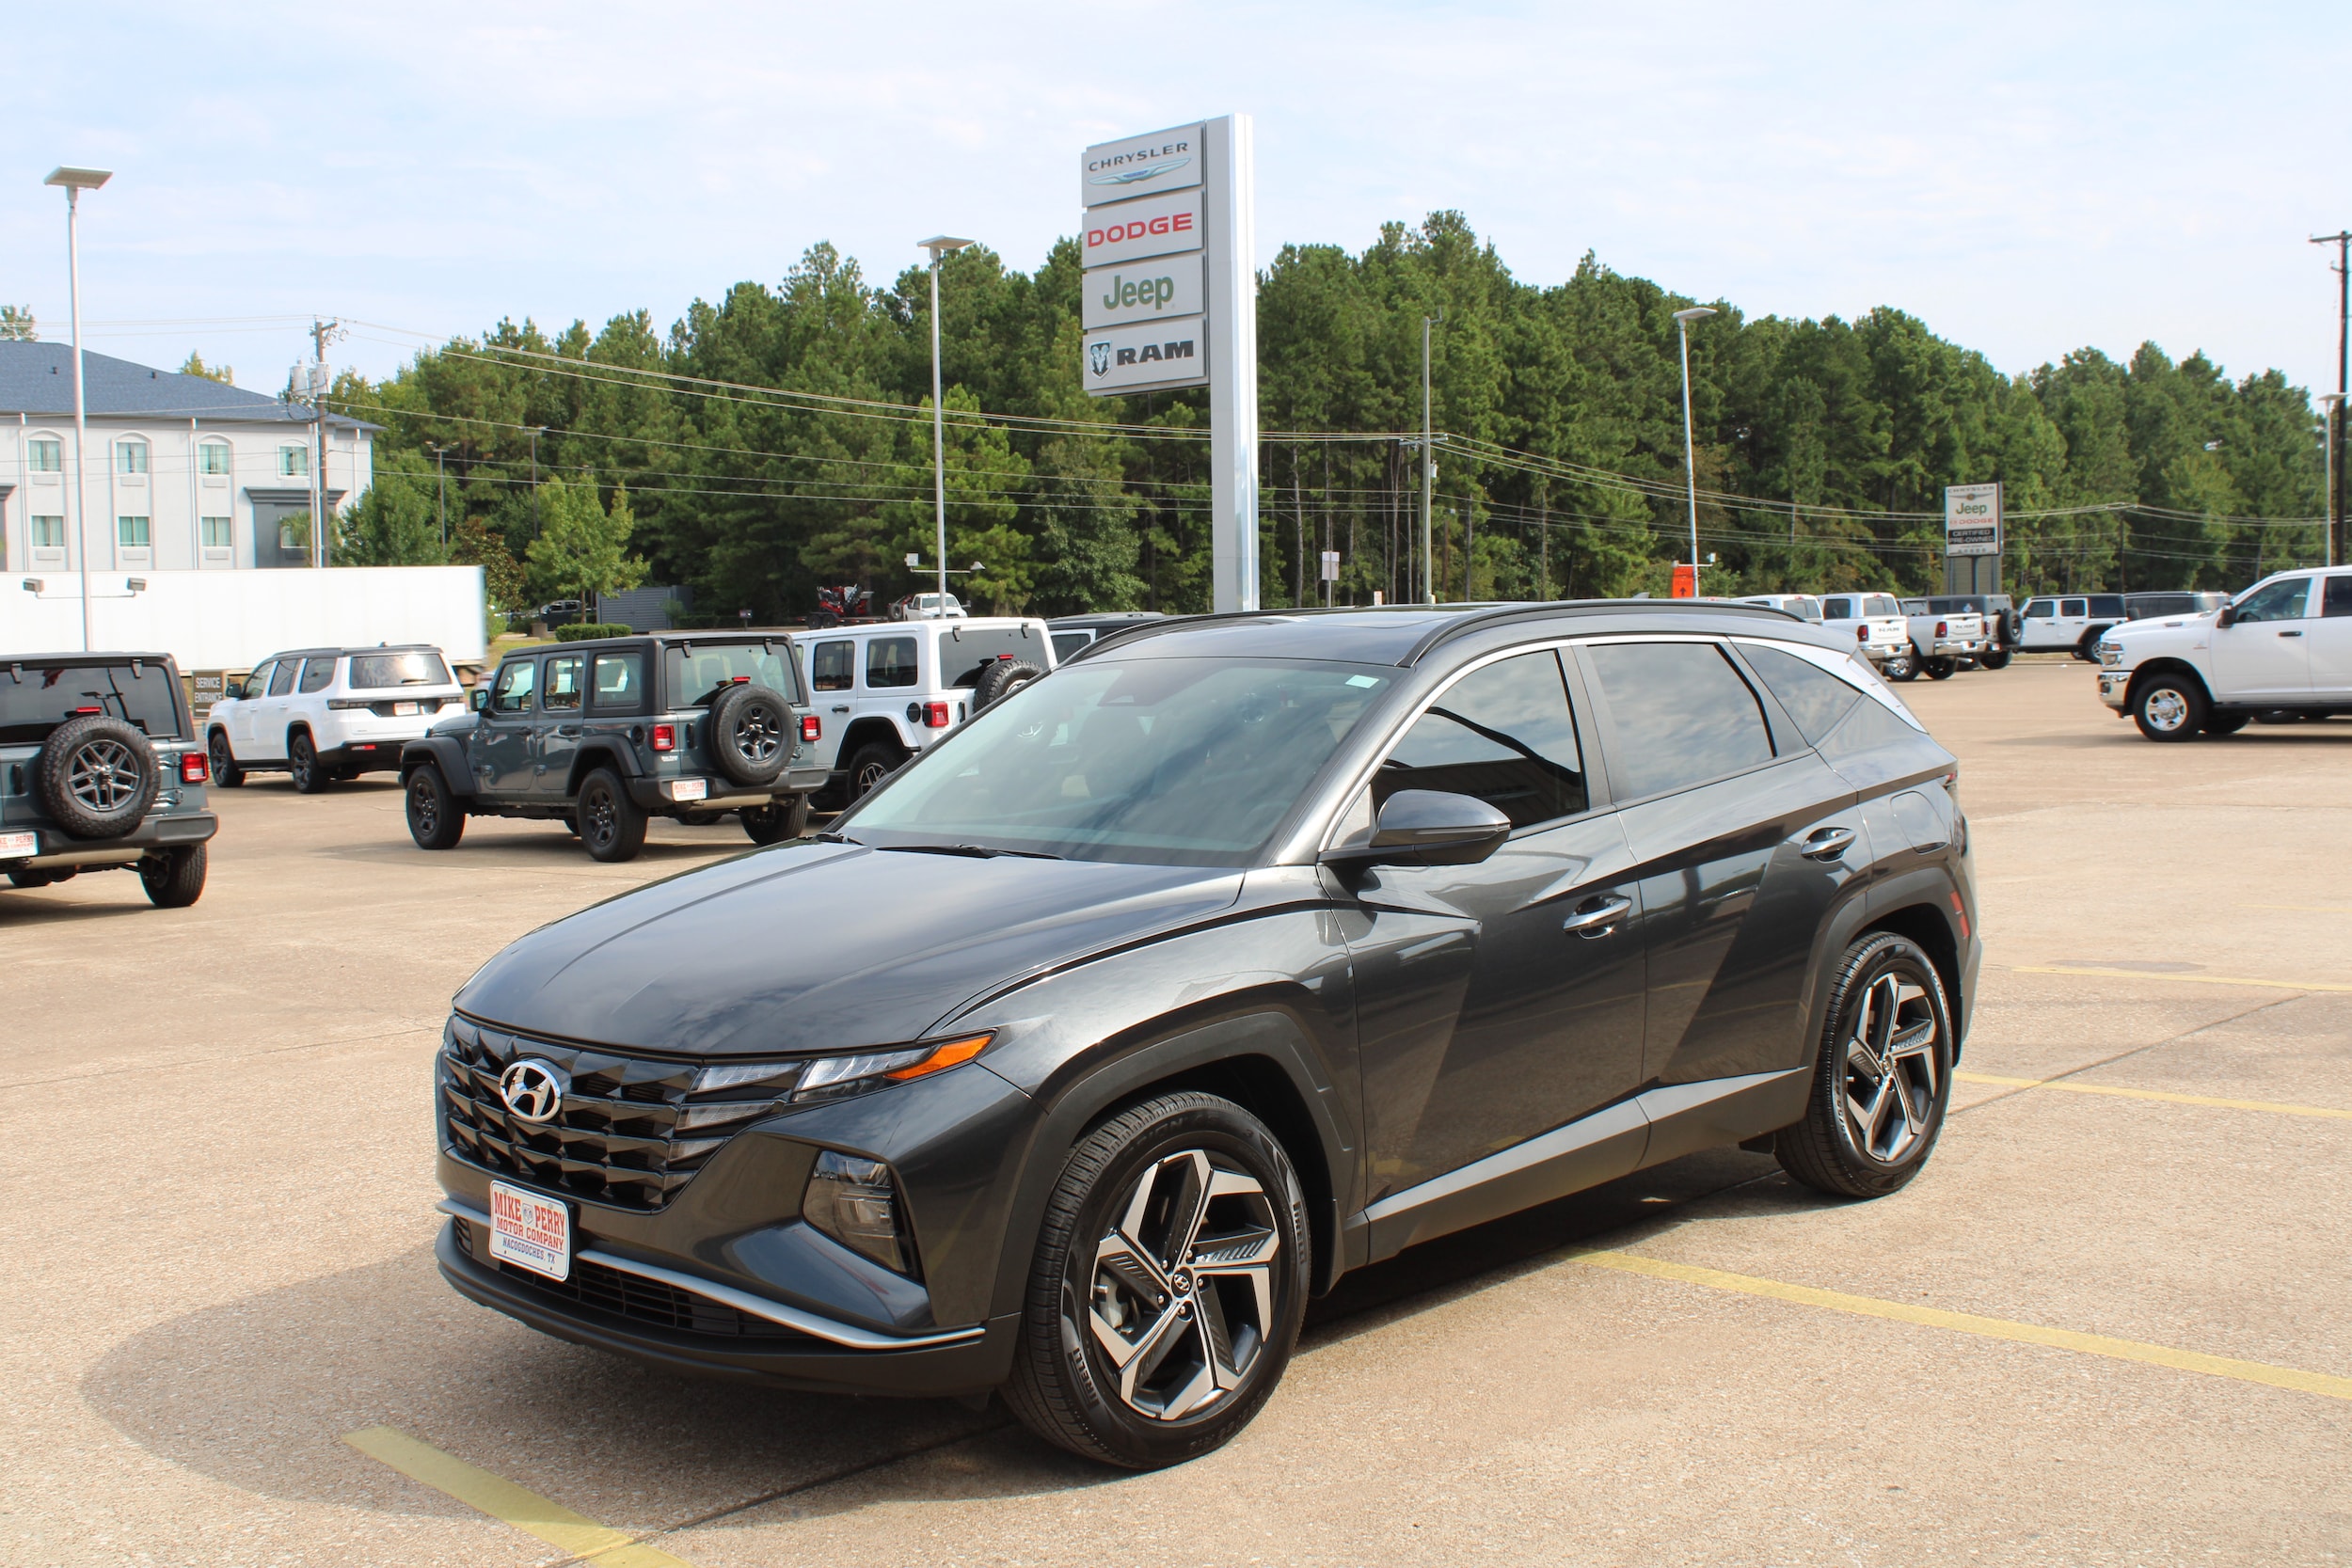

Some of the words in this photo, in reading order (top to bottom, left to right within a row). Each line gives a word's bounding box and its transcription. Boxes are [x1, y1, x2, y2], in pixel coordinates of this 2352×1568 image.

[1089, 142, 1188, 172] CHRYSLER
[1088, 213, 1193, 248] DODGE
[1103, 275, 1174, 310] Jeep
[1117, 341, 1194, 366] RAM
[1956, 502, 1987, 515] Jeep
[1952, 529, 1991, 537] CERTIFIED
[196, 677, 221, 689] SERVICE
[194, 692, 223, 703] ENTRANCE
[494, 1192, 522, 1222] MIKE
[534, 1205, 565, 1237] PERRY
[497, 1217, 524, 1237] MOTOR
[527, 1227, 564, 1251] COMPANY
[548, 1252, 556, 1264] TX
[1069, 1347, 1100, 1408] PIRELLI
